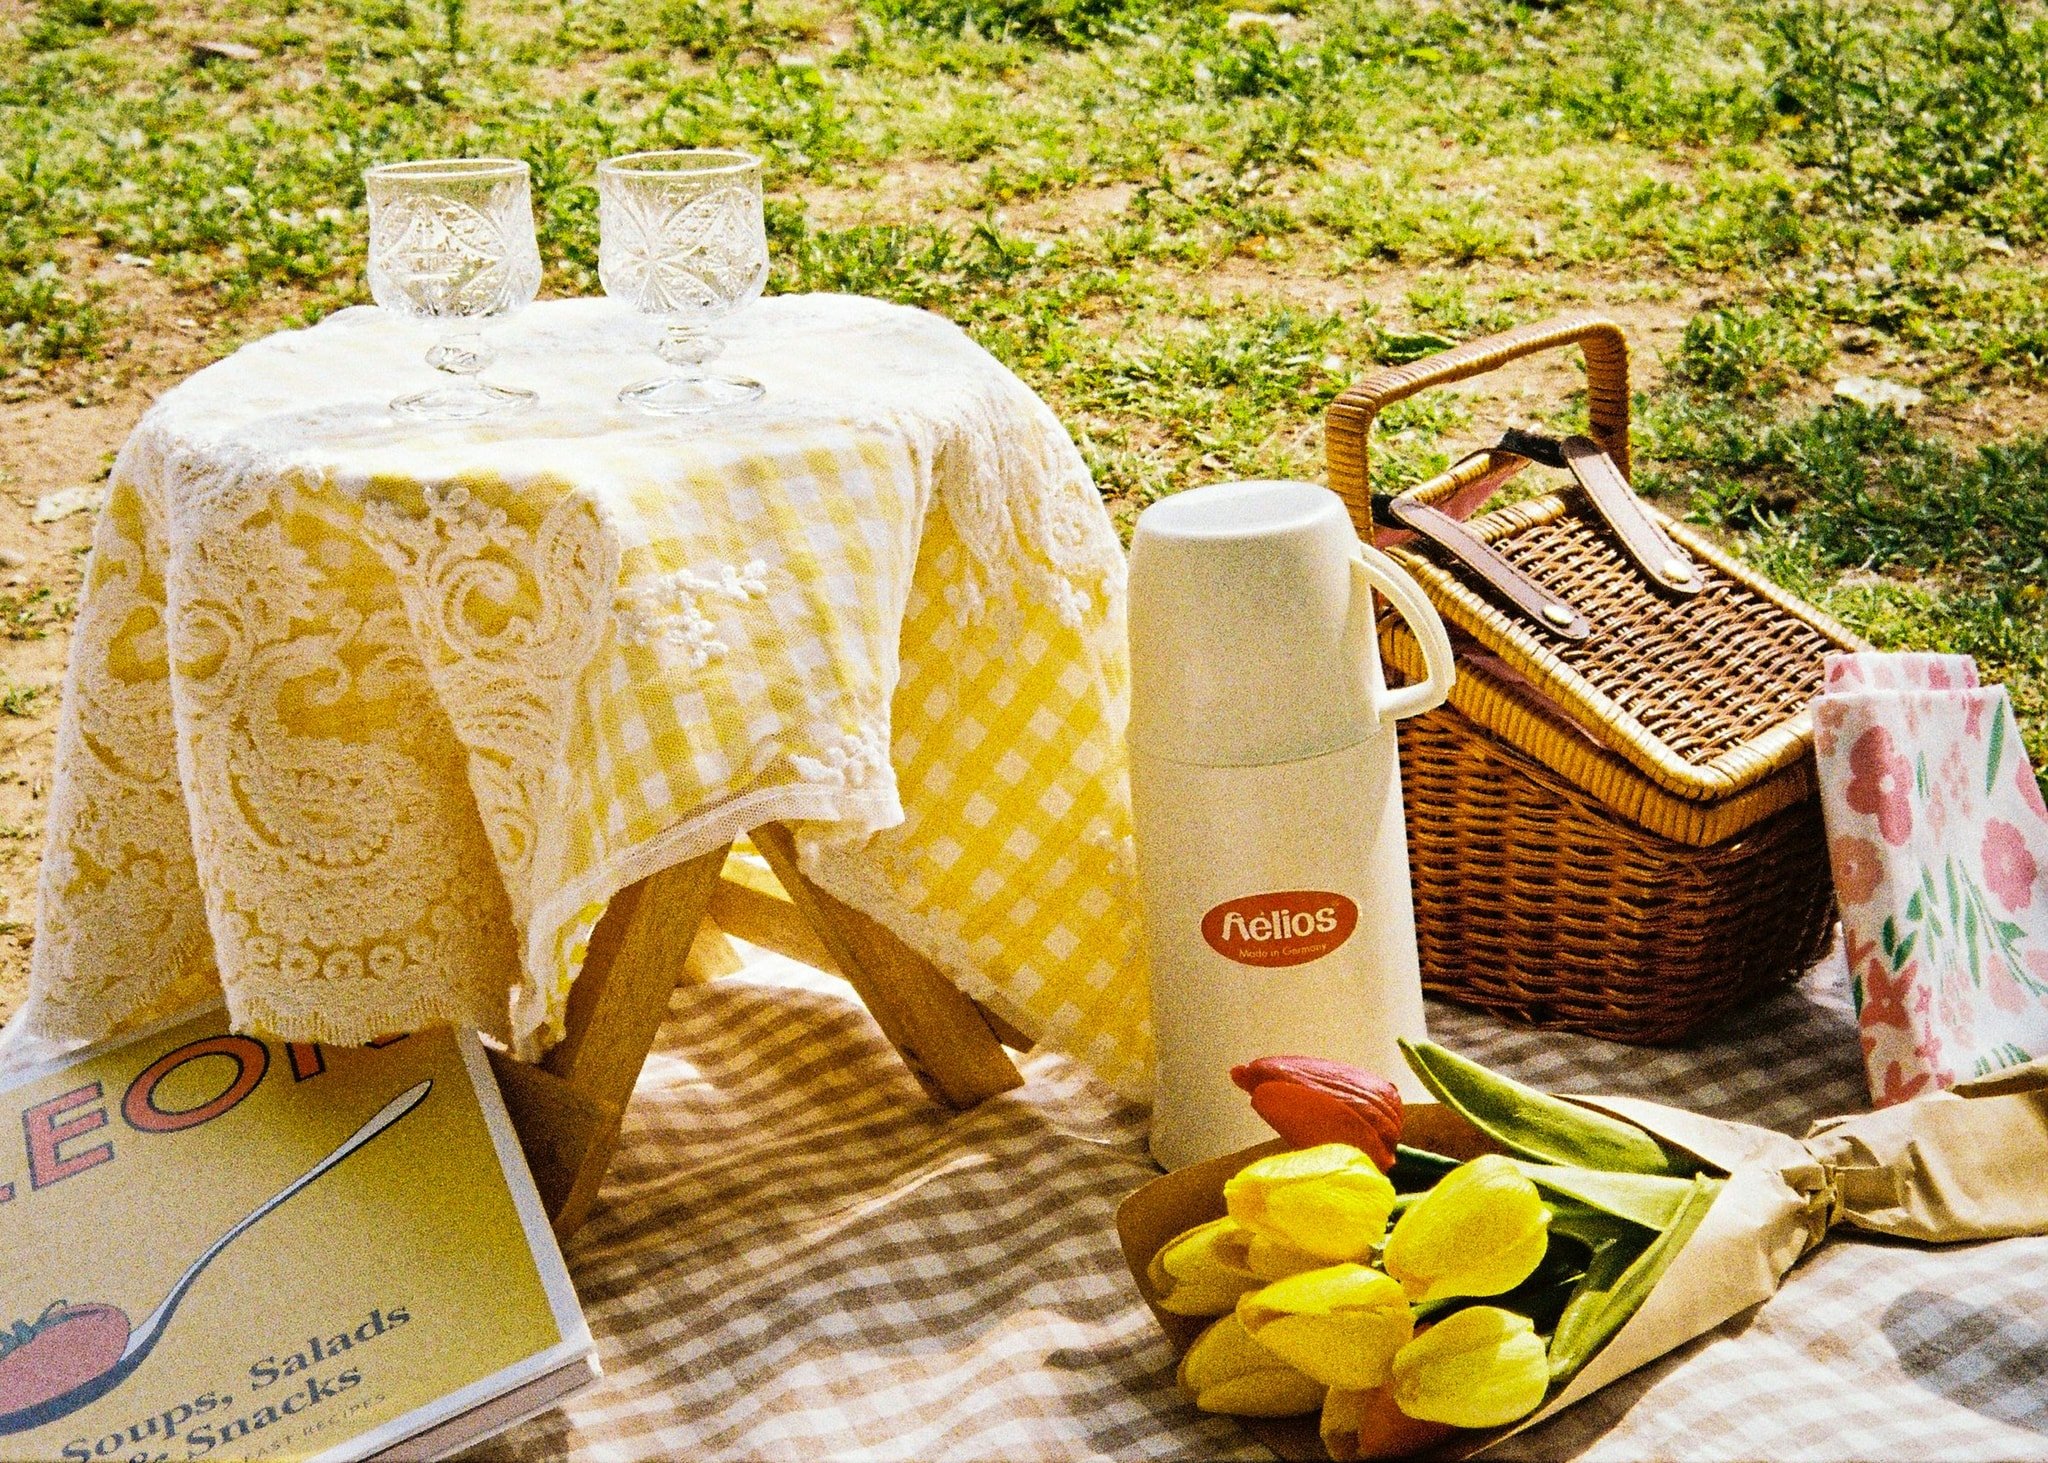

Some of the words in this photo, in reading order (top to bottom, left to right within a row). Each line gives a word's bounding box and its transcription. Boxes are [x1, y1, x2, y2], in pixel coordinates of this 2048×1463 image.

[1270, 948, 1280, 958] in
[0, 1033, 410, 1205] EO
[61, 1391, 233, 1463] Soups,
[250, 1305, 410, 1391] Salads
[186, 1366, 363, 1461] Snacks
